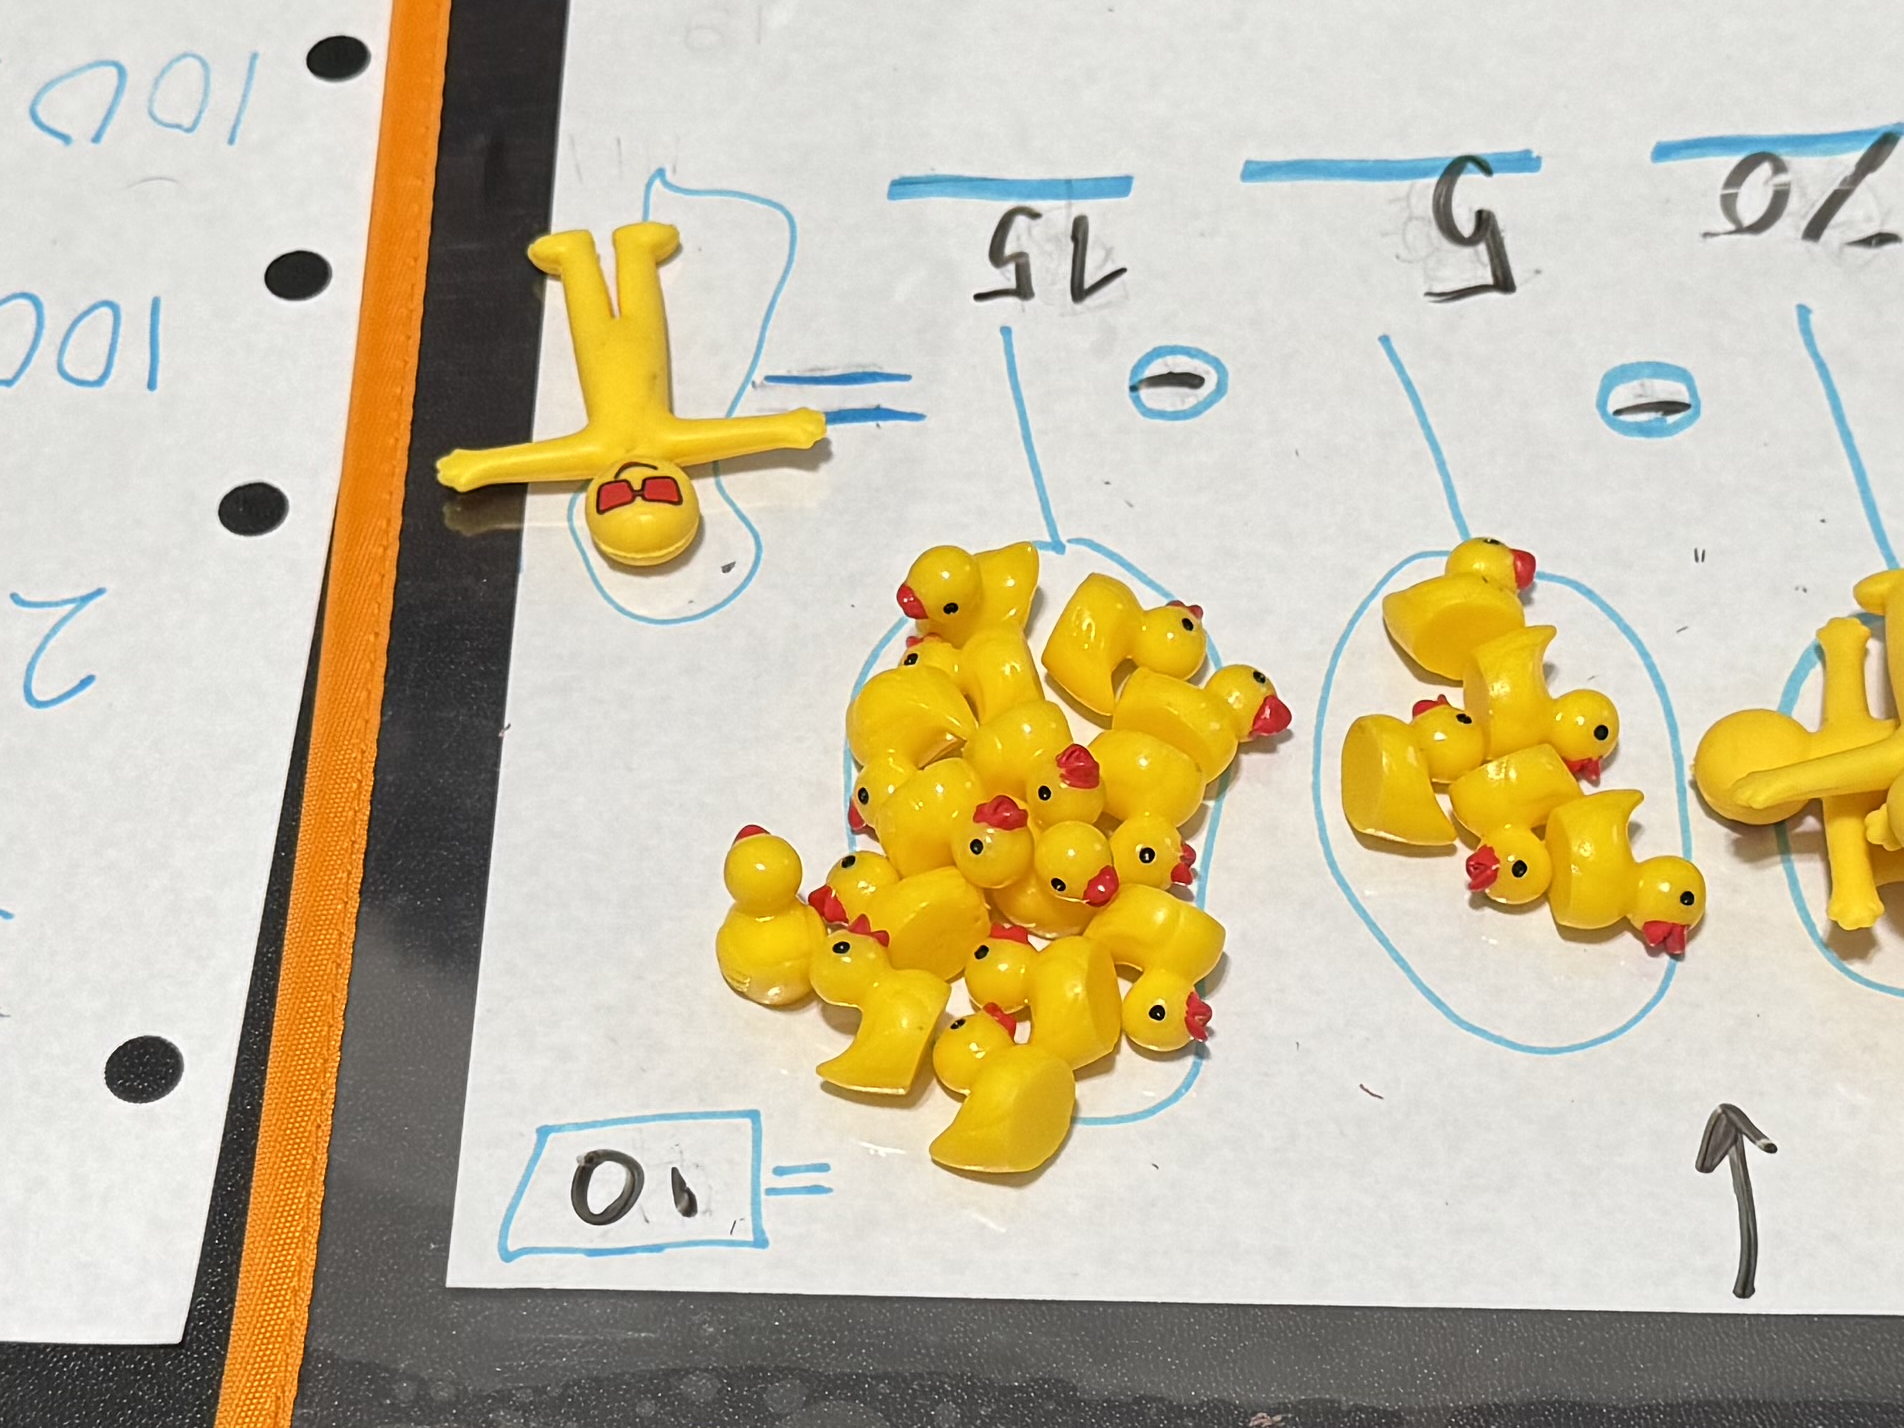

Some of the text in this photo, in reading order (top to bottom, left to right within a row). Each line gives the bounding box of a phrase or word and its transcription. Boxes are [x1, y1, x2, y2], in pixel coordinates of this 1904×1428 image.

[28, 52, 259, 147] 100
[1422, 155, 1526, 303] 5
[1702, 130, 1904, 249] 70
[975, 204, 1129, 304] 15
[573, 1151, 696, 1225] 10
